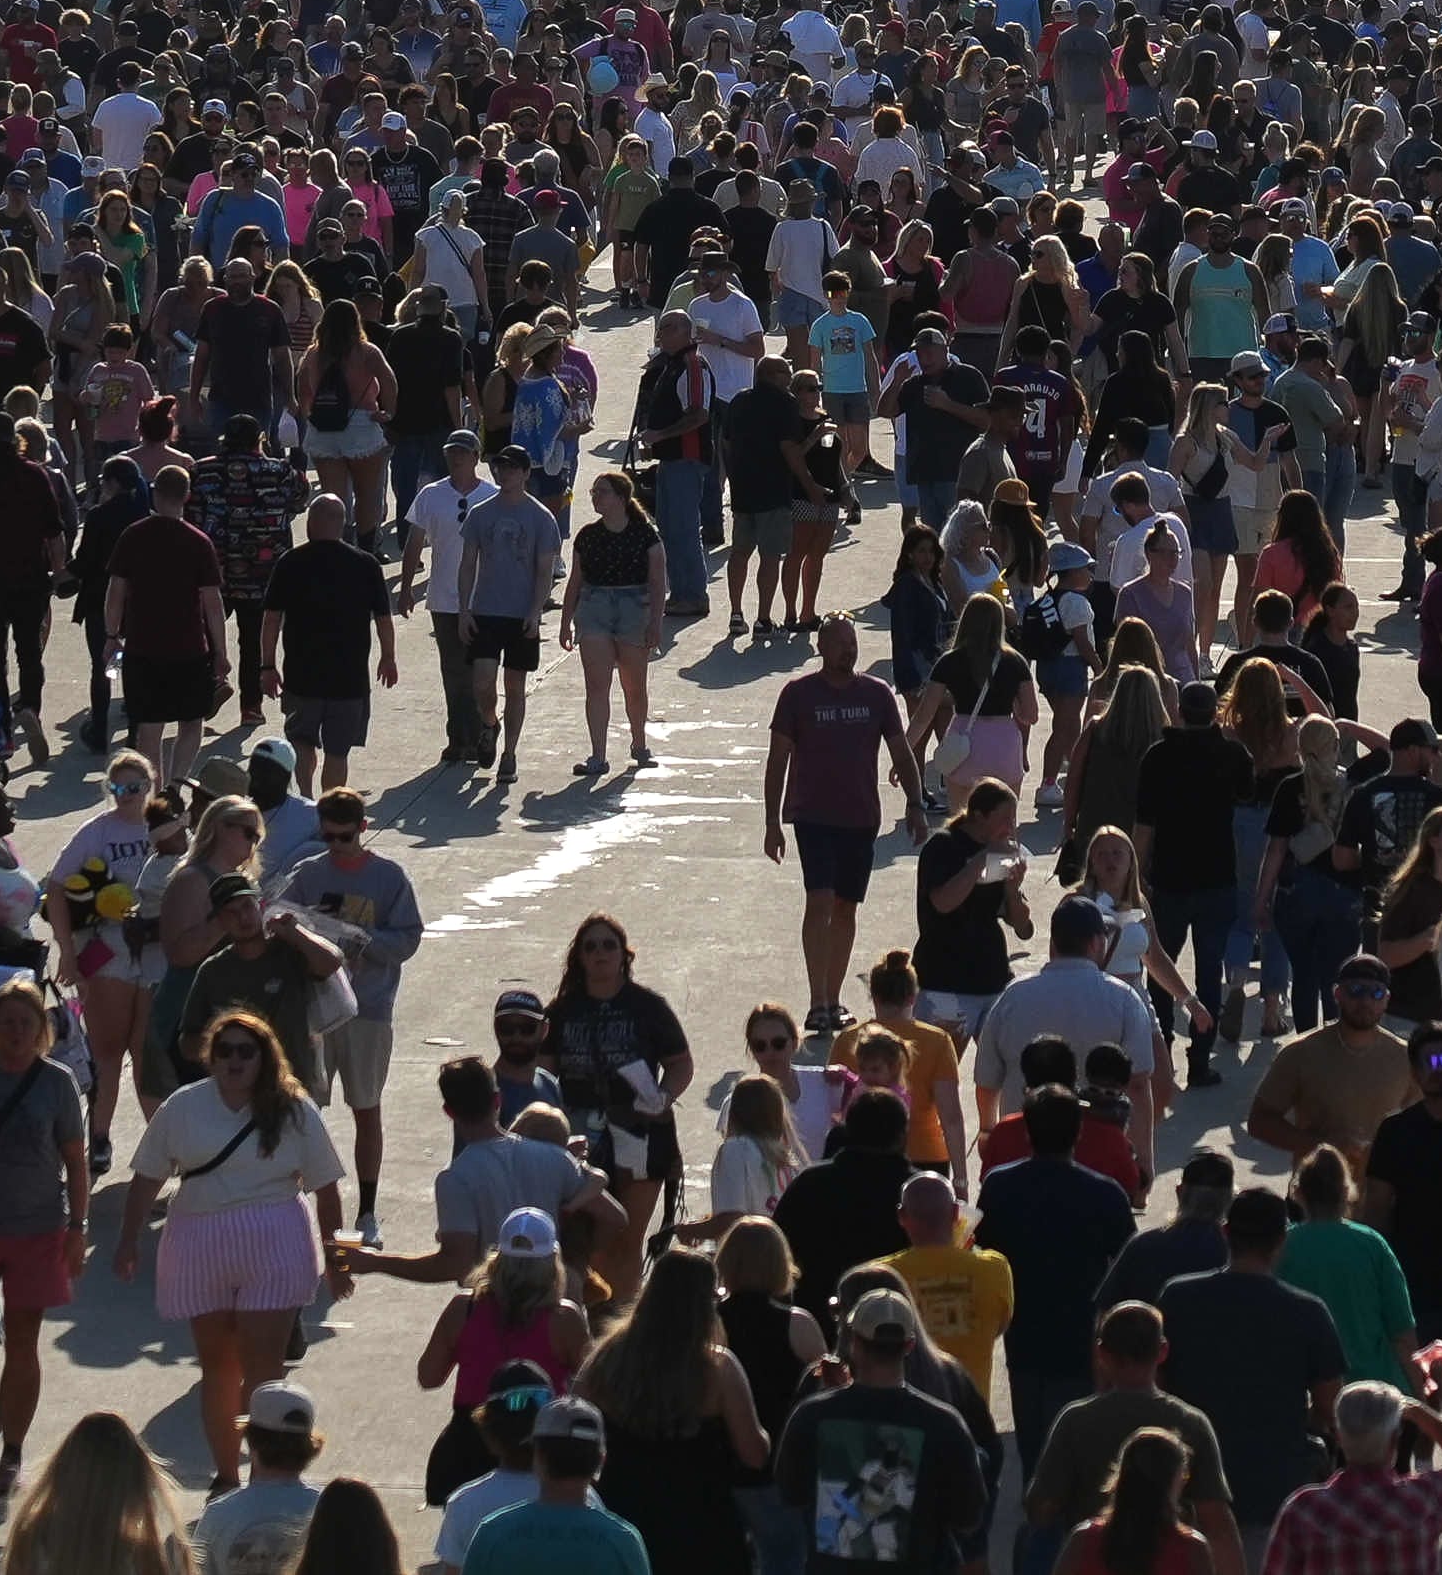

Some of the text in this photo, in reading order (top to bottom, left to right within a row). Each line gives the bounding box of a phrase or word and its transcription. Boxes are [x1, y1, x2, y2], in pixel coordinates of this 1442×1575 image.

[1024, 383, 1060, 401] ARAUJO
[815, 711, 836, 721] THE
[108, 839, 150, 862] IOW
